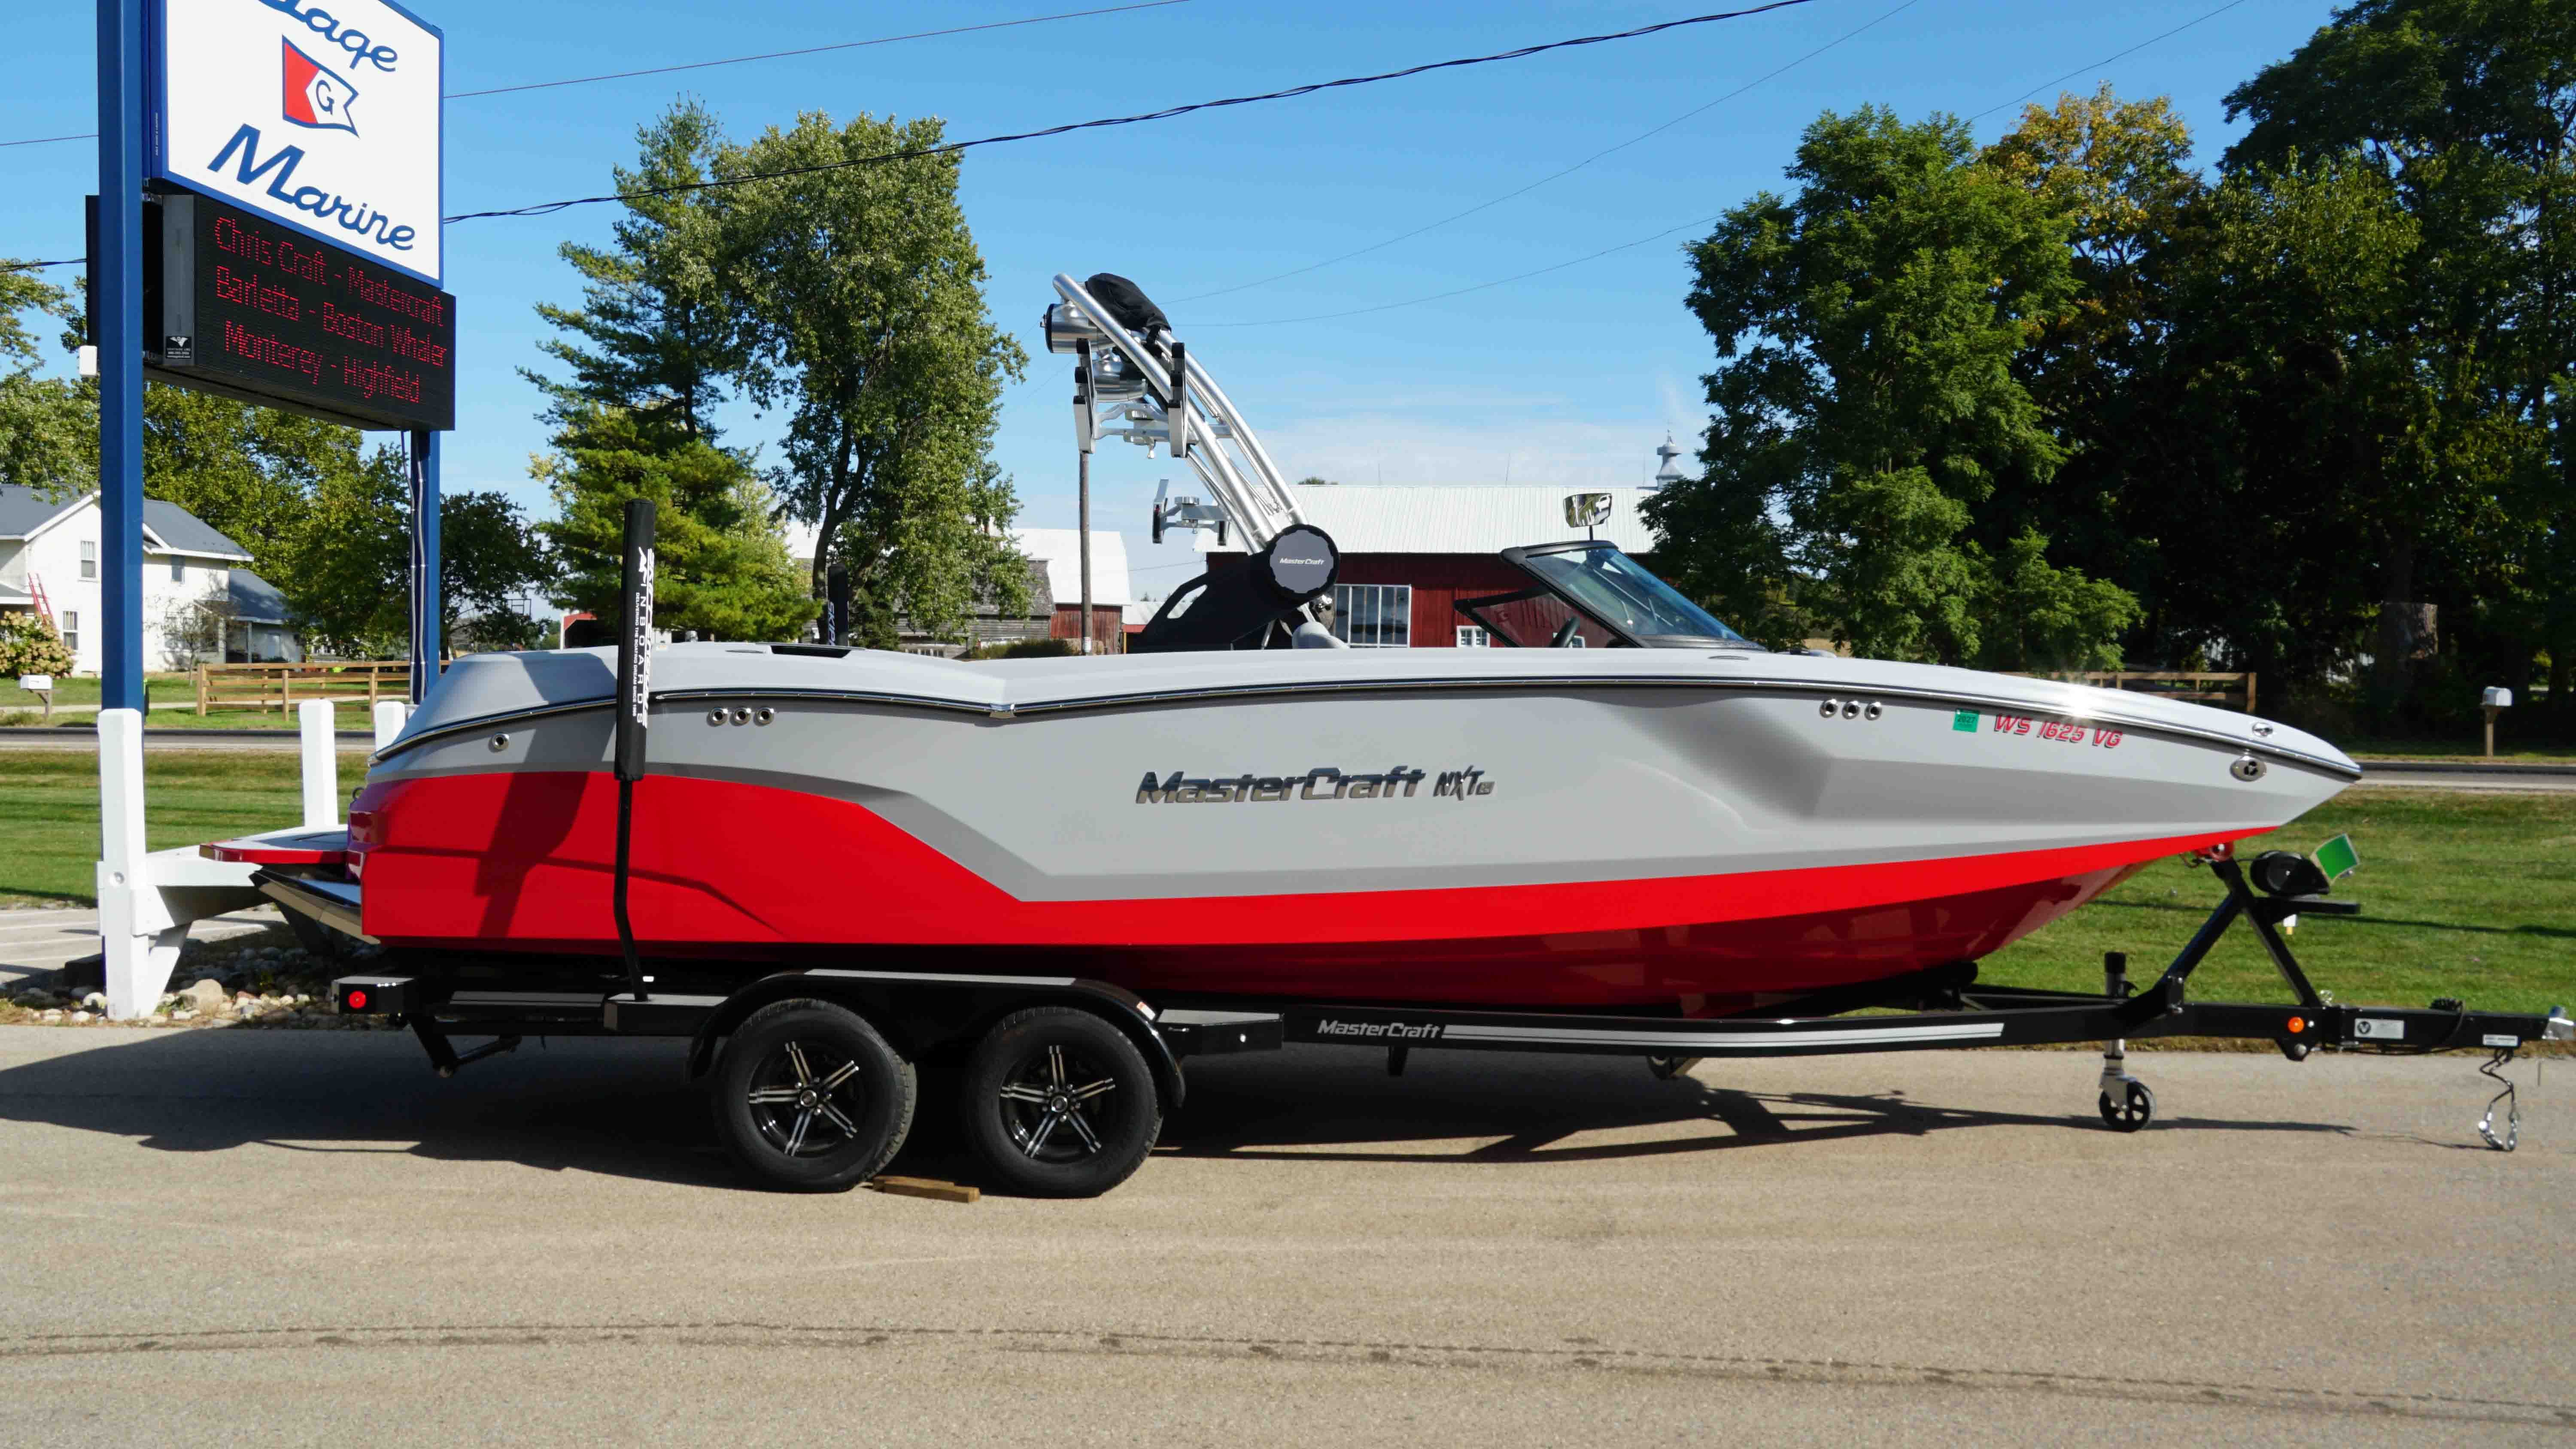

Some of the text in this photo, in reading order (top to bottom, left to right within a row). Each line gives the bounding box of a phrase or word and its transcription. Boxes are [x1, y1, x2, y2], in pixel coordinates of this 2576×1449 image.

[316, 79, 335, 115] G
[207, 123, 415, 251] Marine
[214, 216, 272, 267] Chris
[278, 240, 327, 285] Craft
[347, 266, 443, 327] Mastercraft
[216, 265, 299, 321] Barletta
[323, 301, 385, 348] Boston
[390, 324, 447, 367] Whaler
[224, 319, 323, 385] Monterey
[343, 355, 419, 403] Highfield
[637, 583, 647, 723] INBOARDS
[1994, 714, 2123, 749] WS 1625 VG
[1136, 766, 1426, 803] MasterCraft
[1317, 1019, 1440, 1038] MasterCraft
